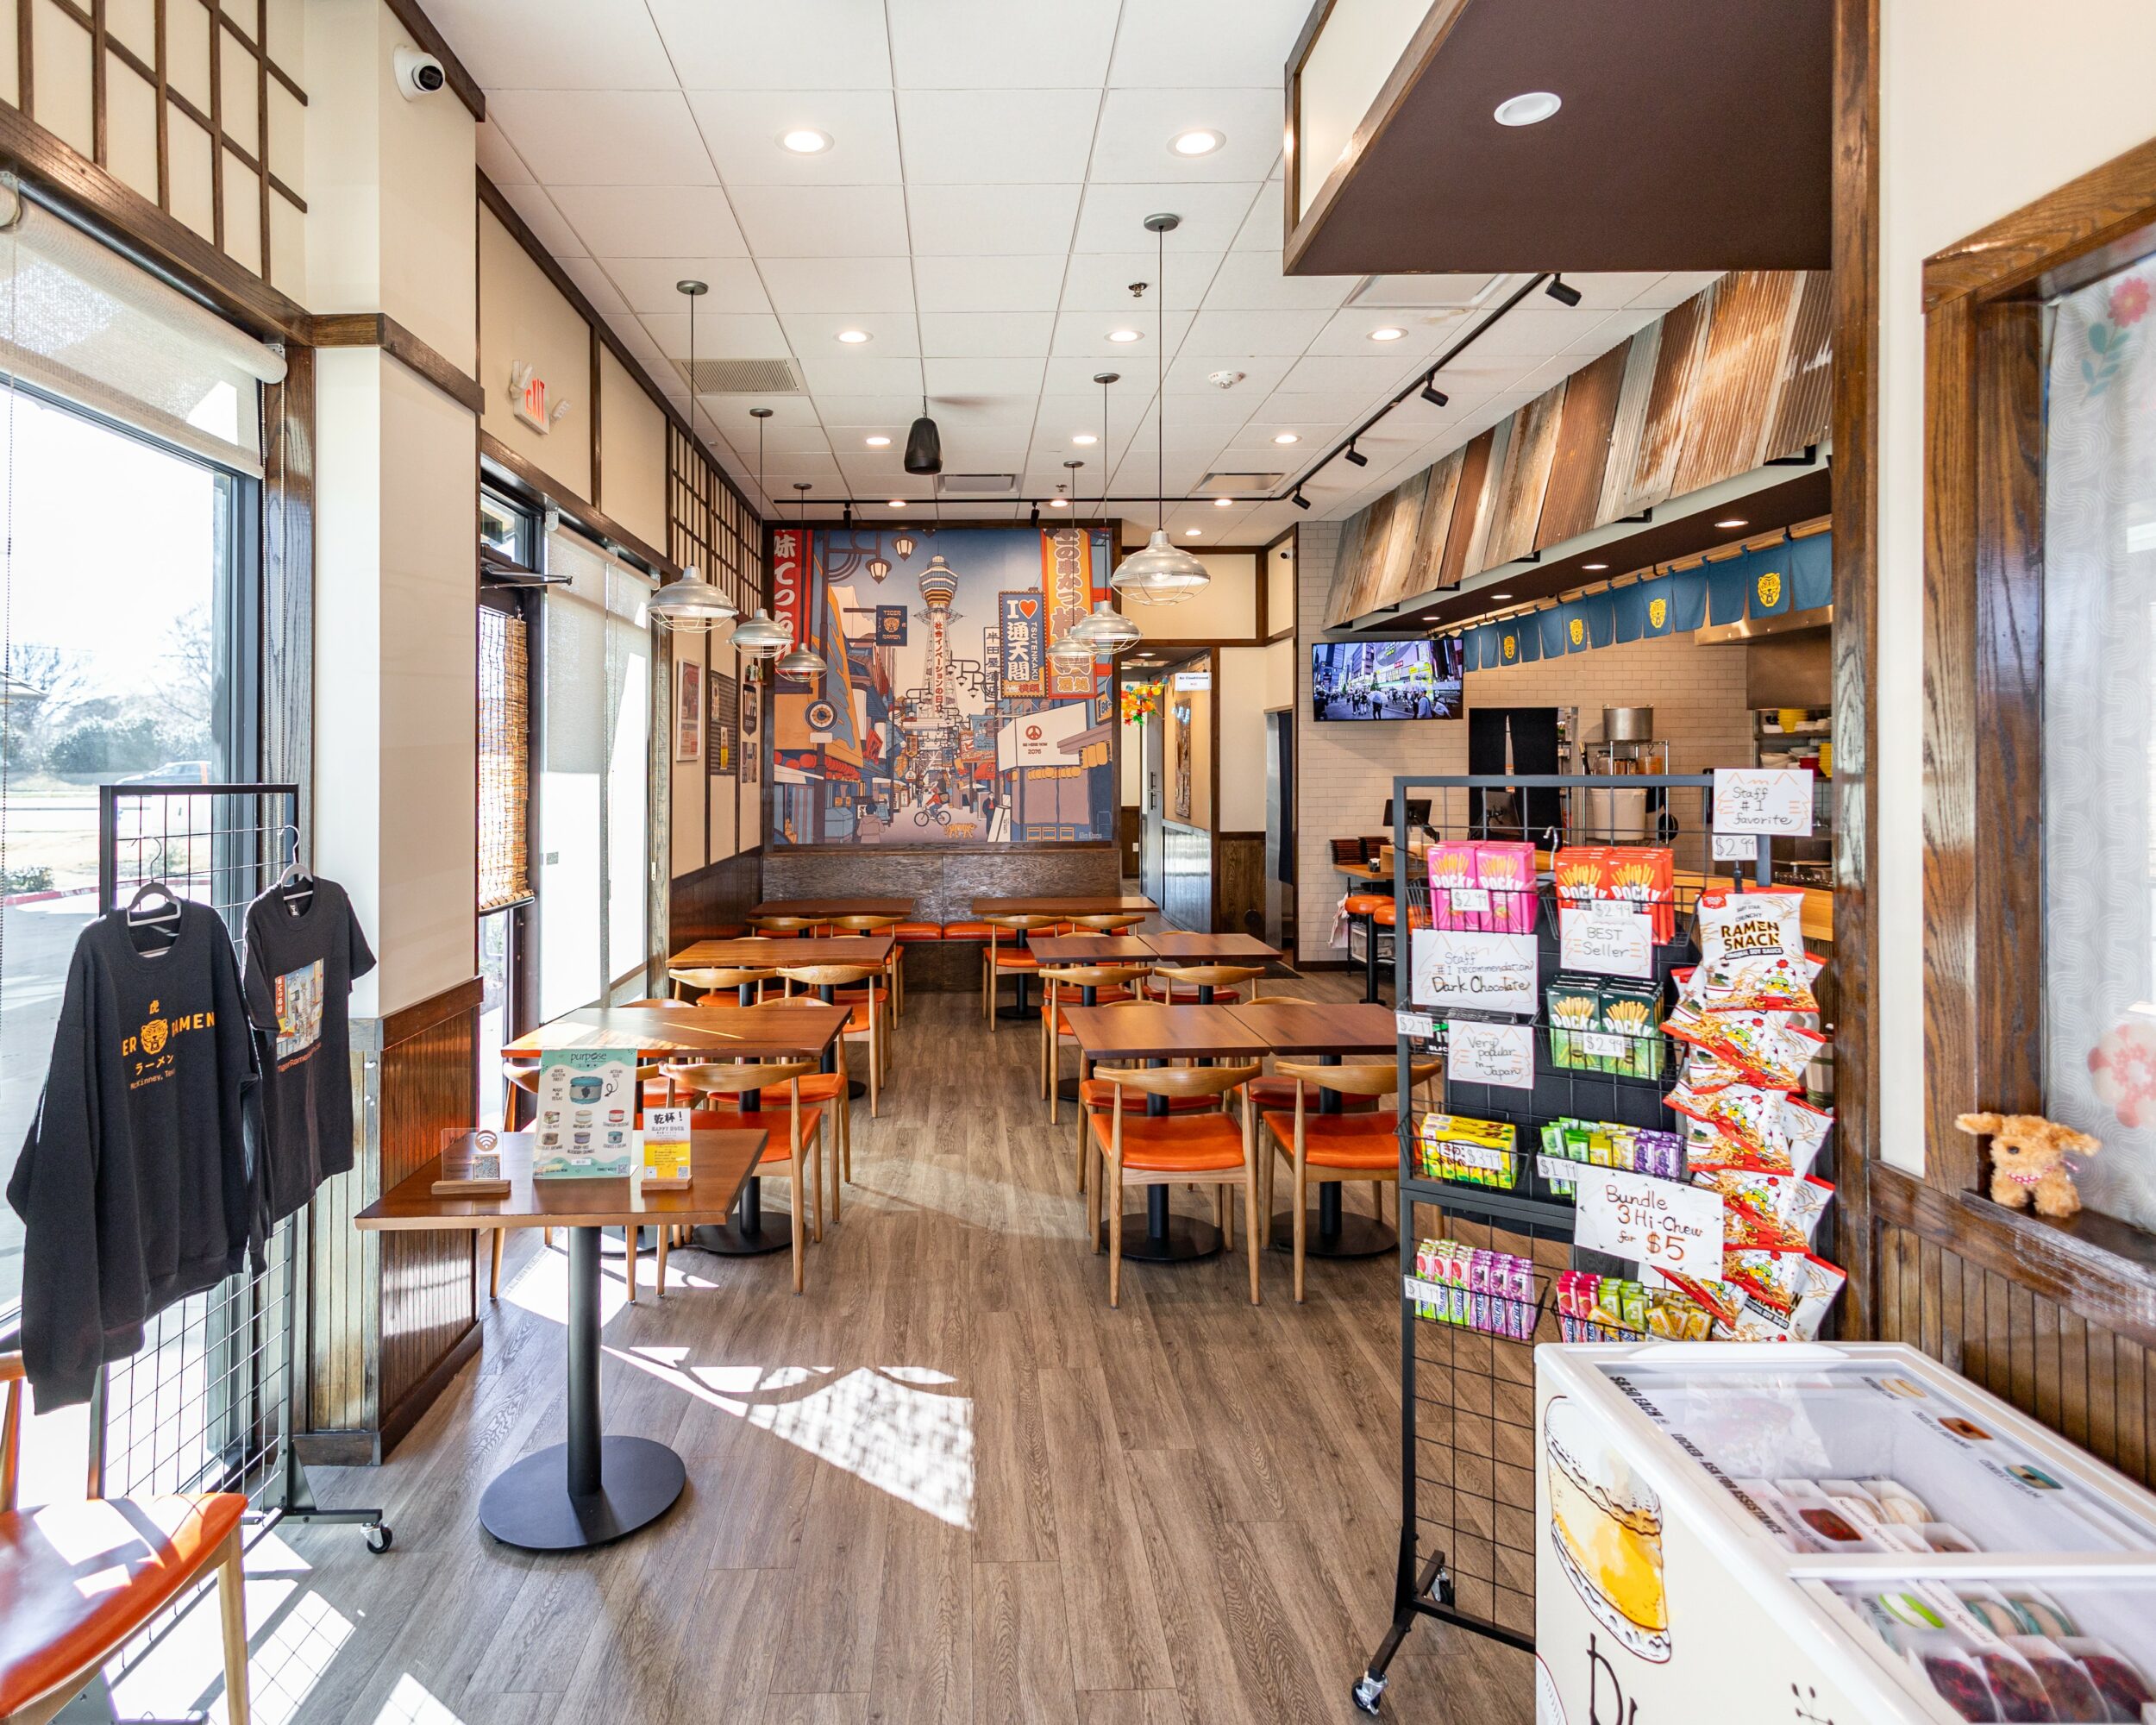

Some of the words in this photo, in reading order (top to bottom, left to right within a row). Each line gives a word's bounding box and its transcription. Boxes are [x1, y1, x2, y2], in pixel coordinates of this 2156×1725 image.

[1006, 622, 1030, 681] 通天閣
[1733, 787, 1768, 800] Staff
[1733, 812, 1792, 825] favorite
[1587, 927, 1623, 941] BEST
[1720, 920, 1780, 938] RAMEN
[1583, 942, 1630, 957] Seller
[1724, 933, 1782, 951] SNACK
[1445, 951, 1476, 965] Staff
[1432, 975, 1468, 994] Dark
[1470, 975, 1531, 994] Chocolate
[1467, 1037, 1500, 1049] Very
[570, 1052, 607, 1063] purpose
[1478, 1047, 1517, 1062] popular
[135, 1055, 174, 1076] ラーメン
[1483, 1065, 1521, 1081] Japan
[1605, 1184, 1668, 1211] Bundle
[1617, 1203, 1631, 1224] 3
[1617, 1230, 1637, 1243] for
[1646, 1231, 1685, 1261] $5
[1609, 1376, 1642, 1396] $8.50
[1632, 1397, 1664, 1417] EACH
[1670, 1433, 1704, 1458] LOCKED
[1700, 1461, 1723, 1475] ASK
[1715, 1476, 1738, 1489] FOR
[1729, 1490, 1787, 1535] ASSISTANCE
